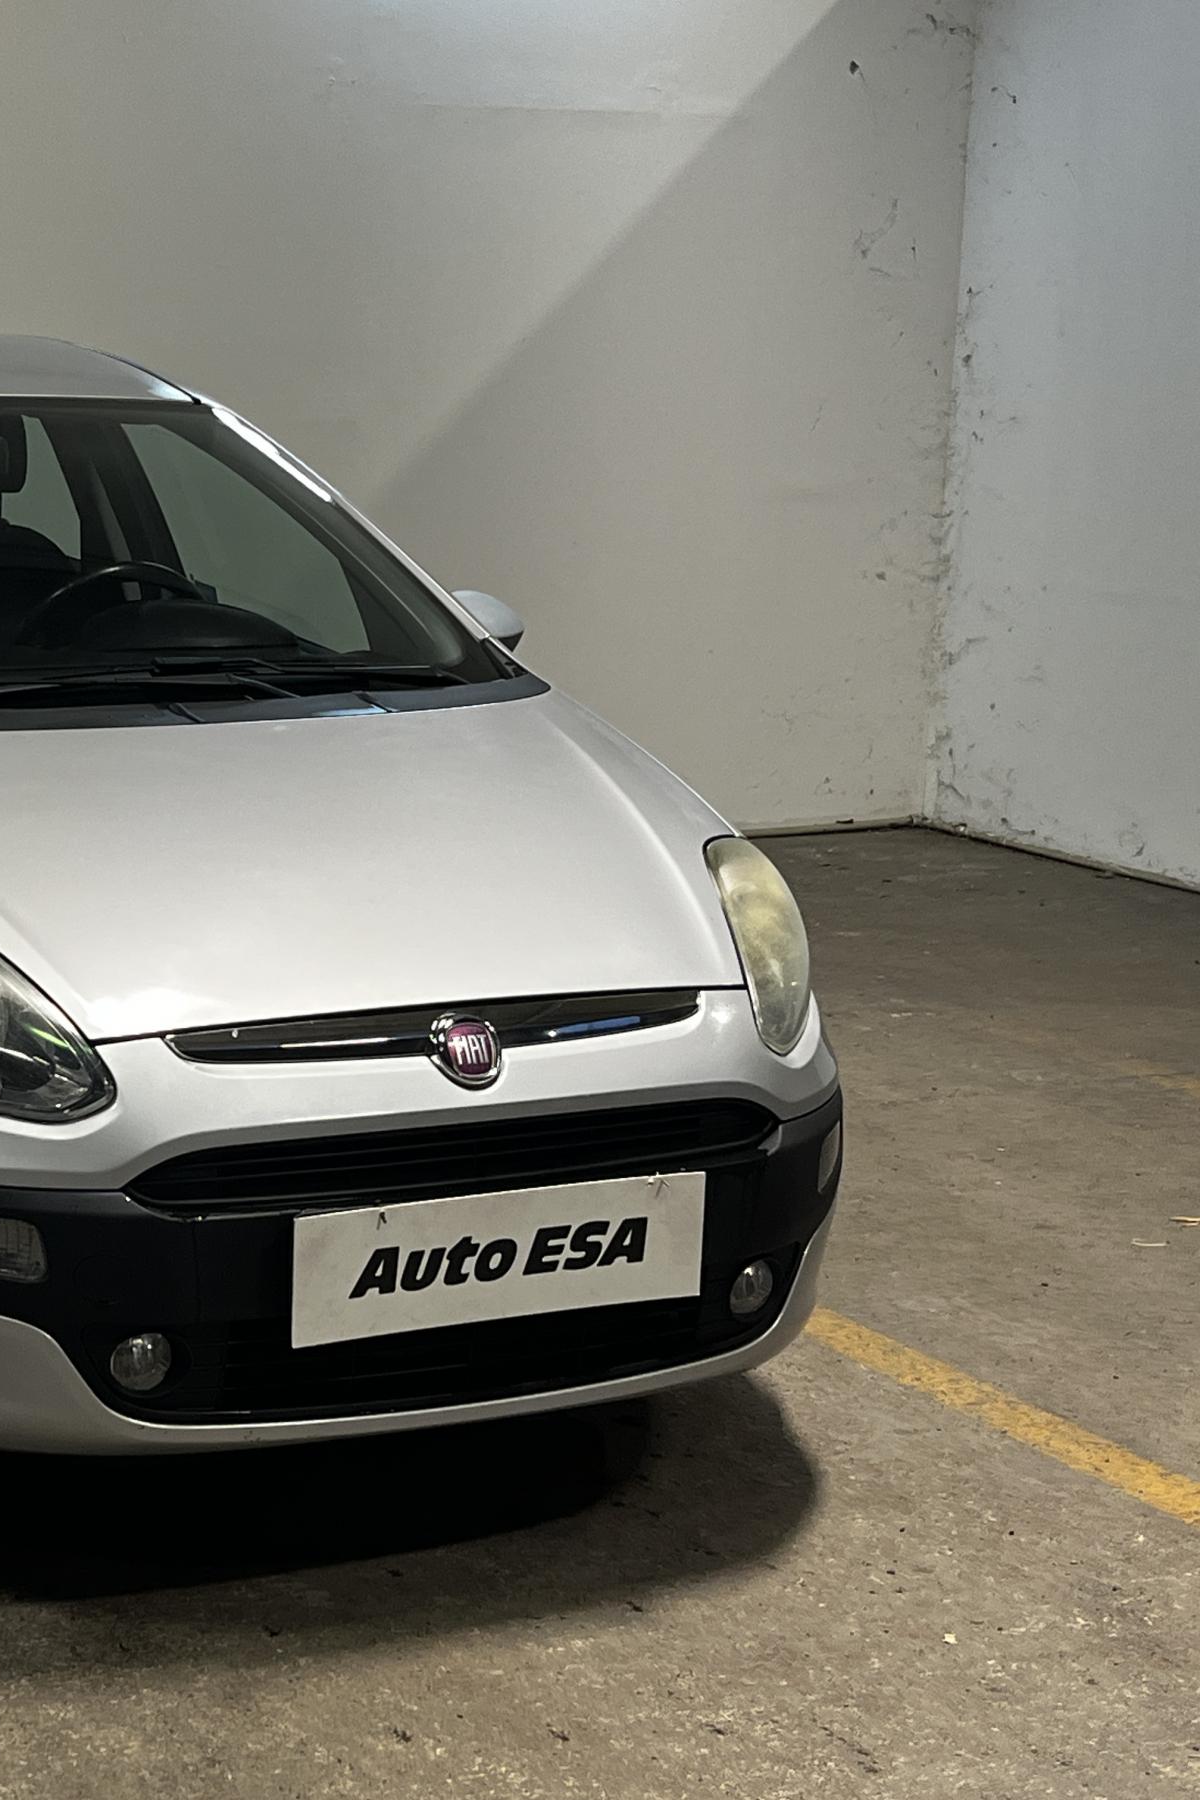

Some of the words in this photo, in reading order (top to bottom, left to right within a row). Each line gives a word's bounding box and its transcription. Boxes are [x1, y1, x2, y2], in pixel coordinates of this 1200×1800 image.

[452, 1034, 489, 1065] FIAT
[348, 1236, 518, 1299] Auto
[522, 1216, 649, 1276] ESA
